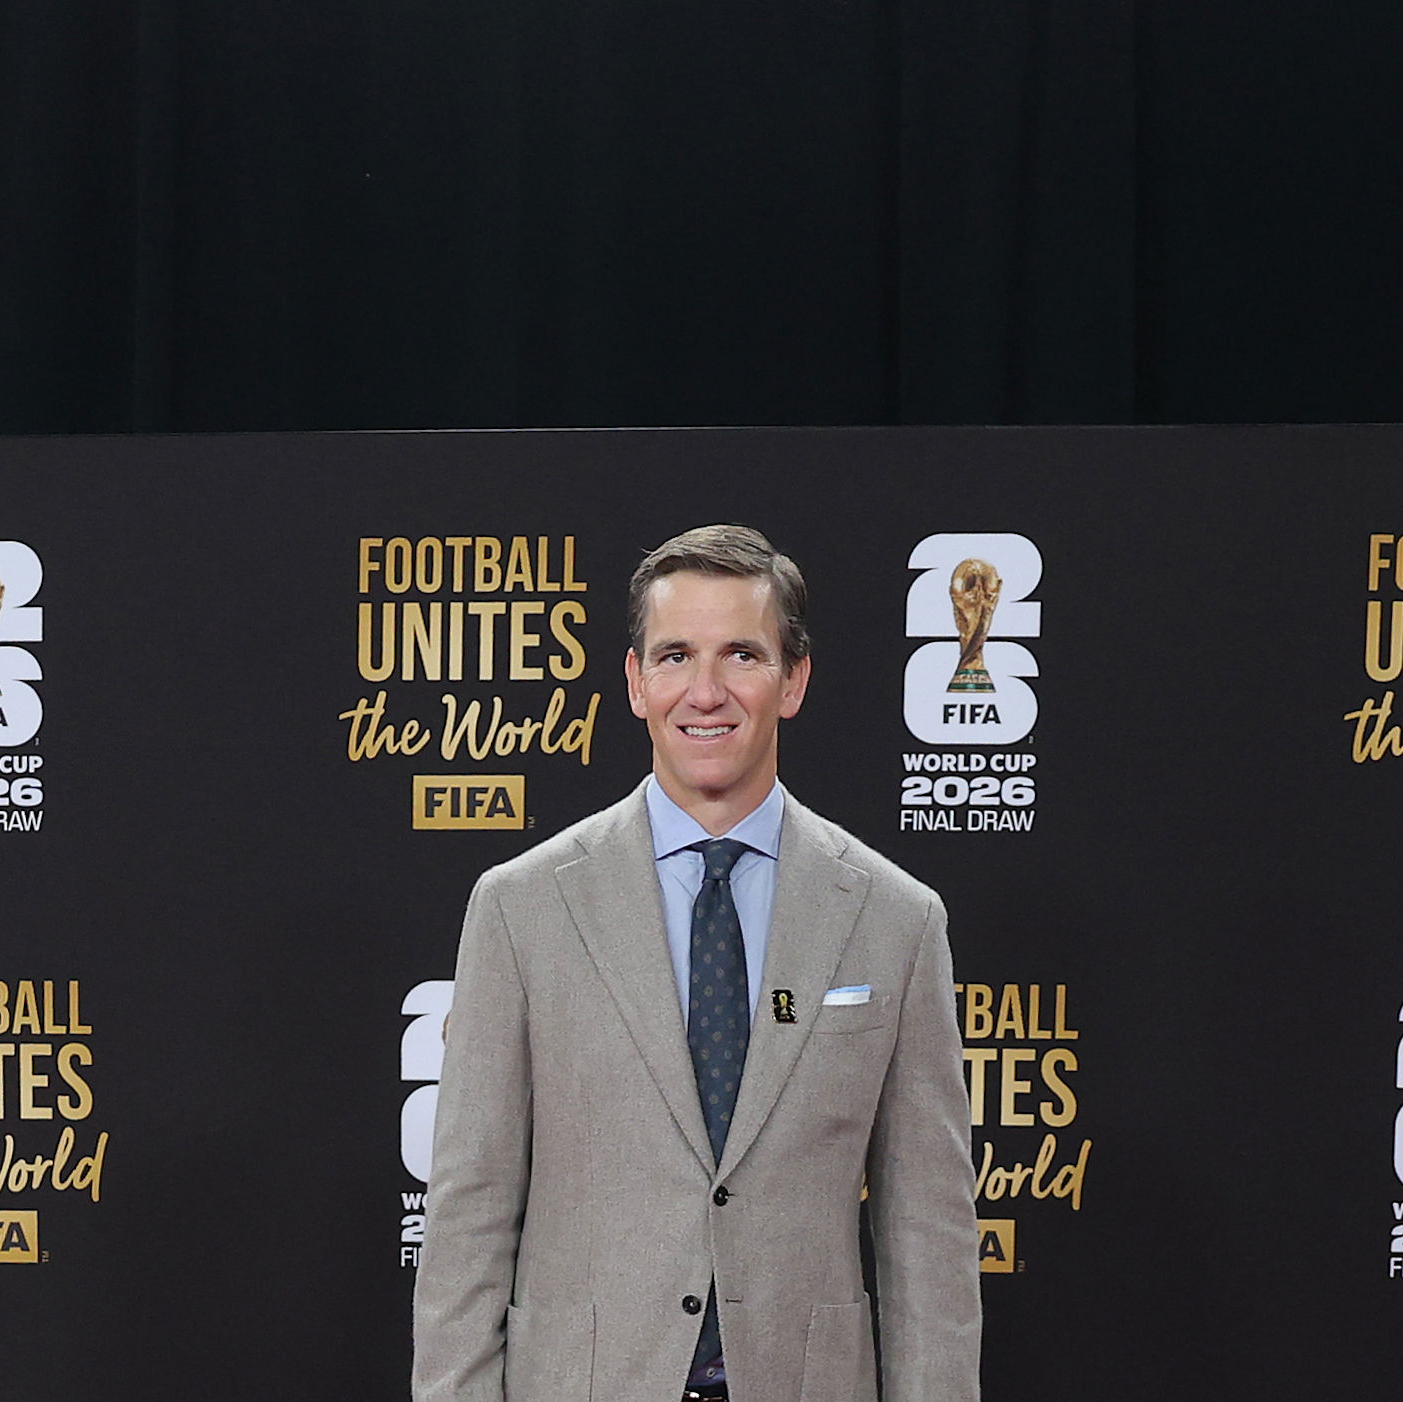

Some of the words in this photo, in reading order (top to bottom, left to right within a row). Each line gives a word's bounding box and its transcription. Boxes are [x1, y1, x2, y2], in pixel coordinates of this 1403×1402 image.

[359, 536, 587, 593] FOOTBALL
[358, 601, 586, 681] UNITES
[339, 691, 430, 761] the
[441, 688, 600, 765] World
[943, 704, 1001, 724] FIFA
[0, 756, 43, 773] CUP
[903, 754, 986, 771] WORLD
[990, 754, 1036, 772] CUP
[425, 787, 516, 818] FIFA
[901, 776, 1035, 806] 2026
[901, 810, 962, 830] FINAL
[968, 810, 1034, 831] DRAW
[954, 983, 1079, 1039] BALL
[962, 1048, 1079, 1127] TES
